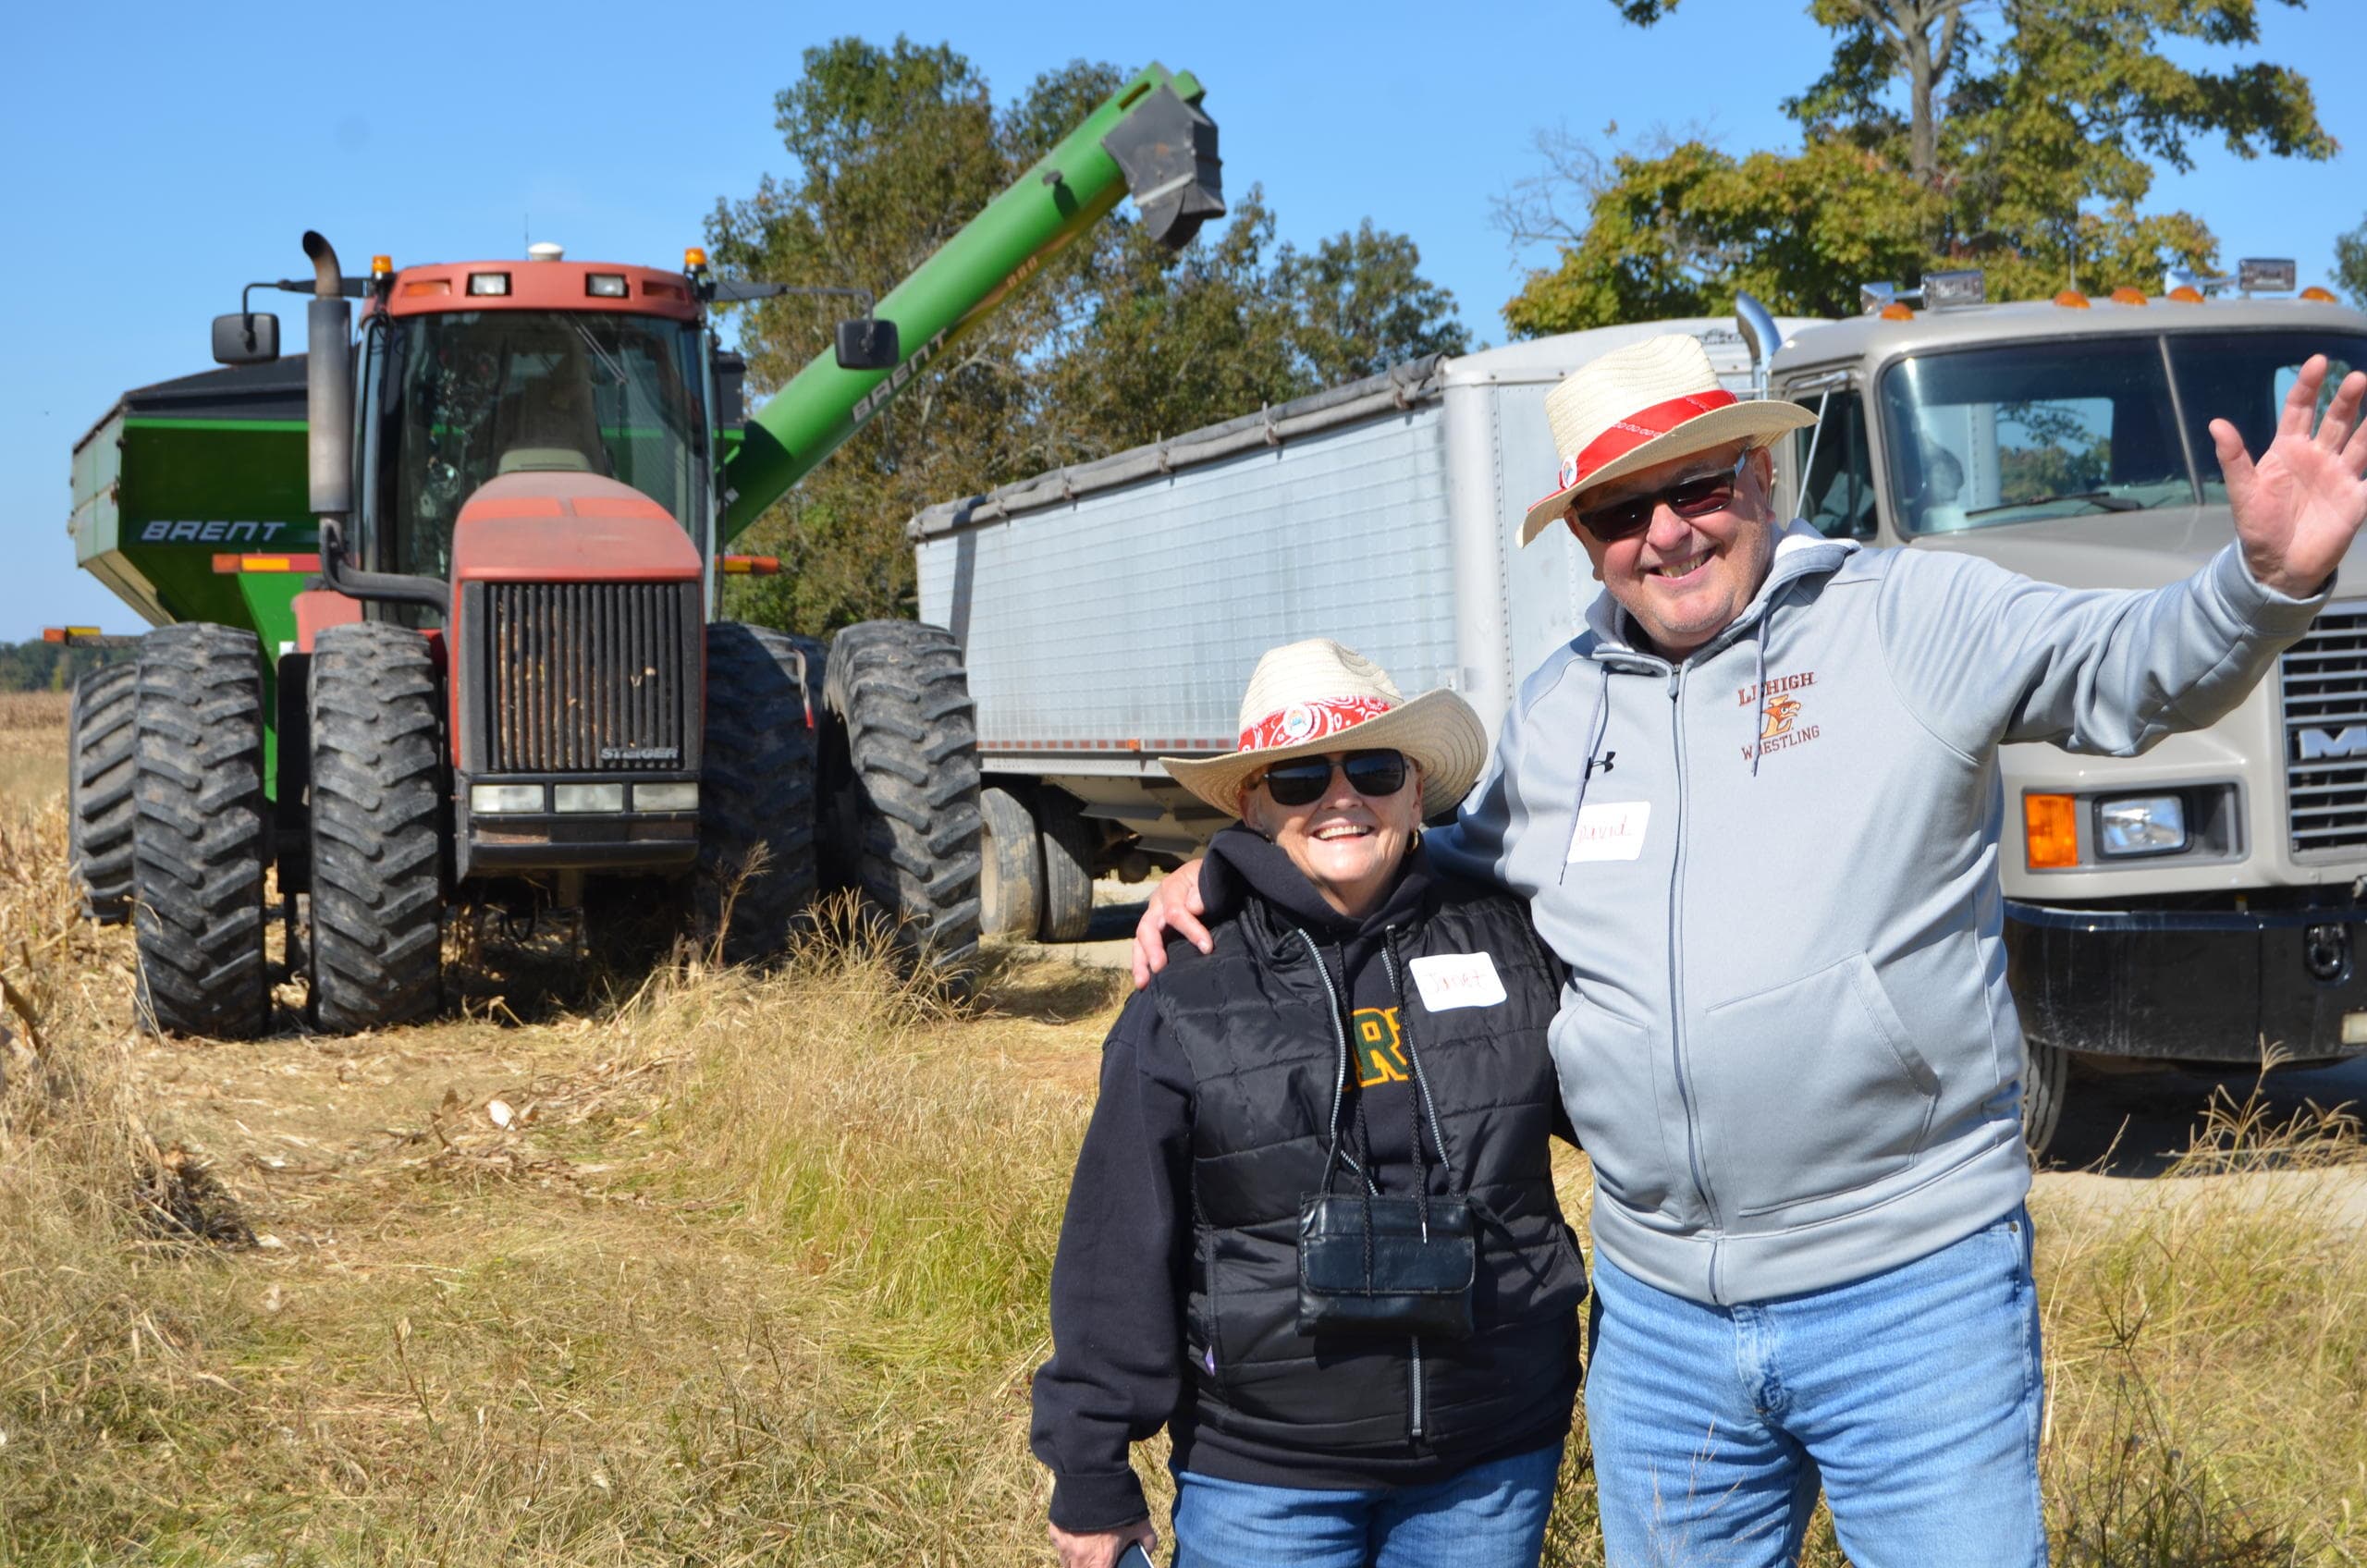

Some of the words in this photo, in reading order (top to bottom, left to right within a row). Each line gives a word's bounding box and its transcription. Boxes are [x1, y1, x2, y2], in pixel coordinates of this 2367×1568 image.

[852, 326, 947, 423] BRENT
[141, 521, 287, 541] BRENT
[601, 747, 679, 760] STEIGER
